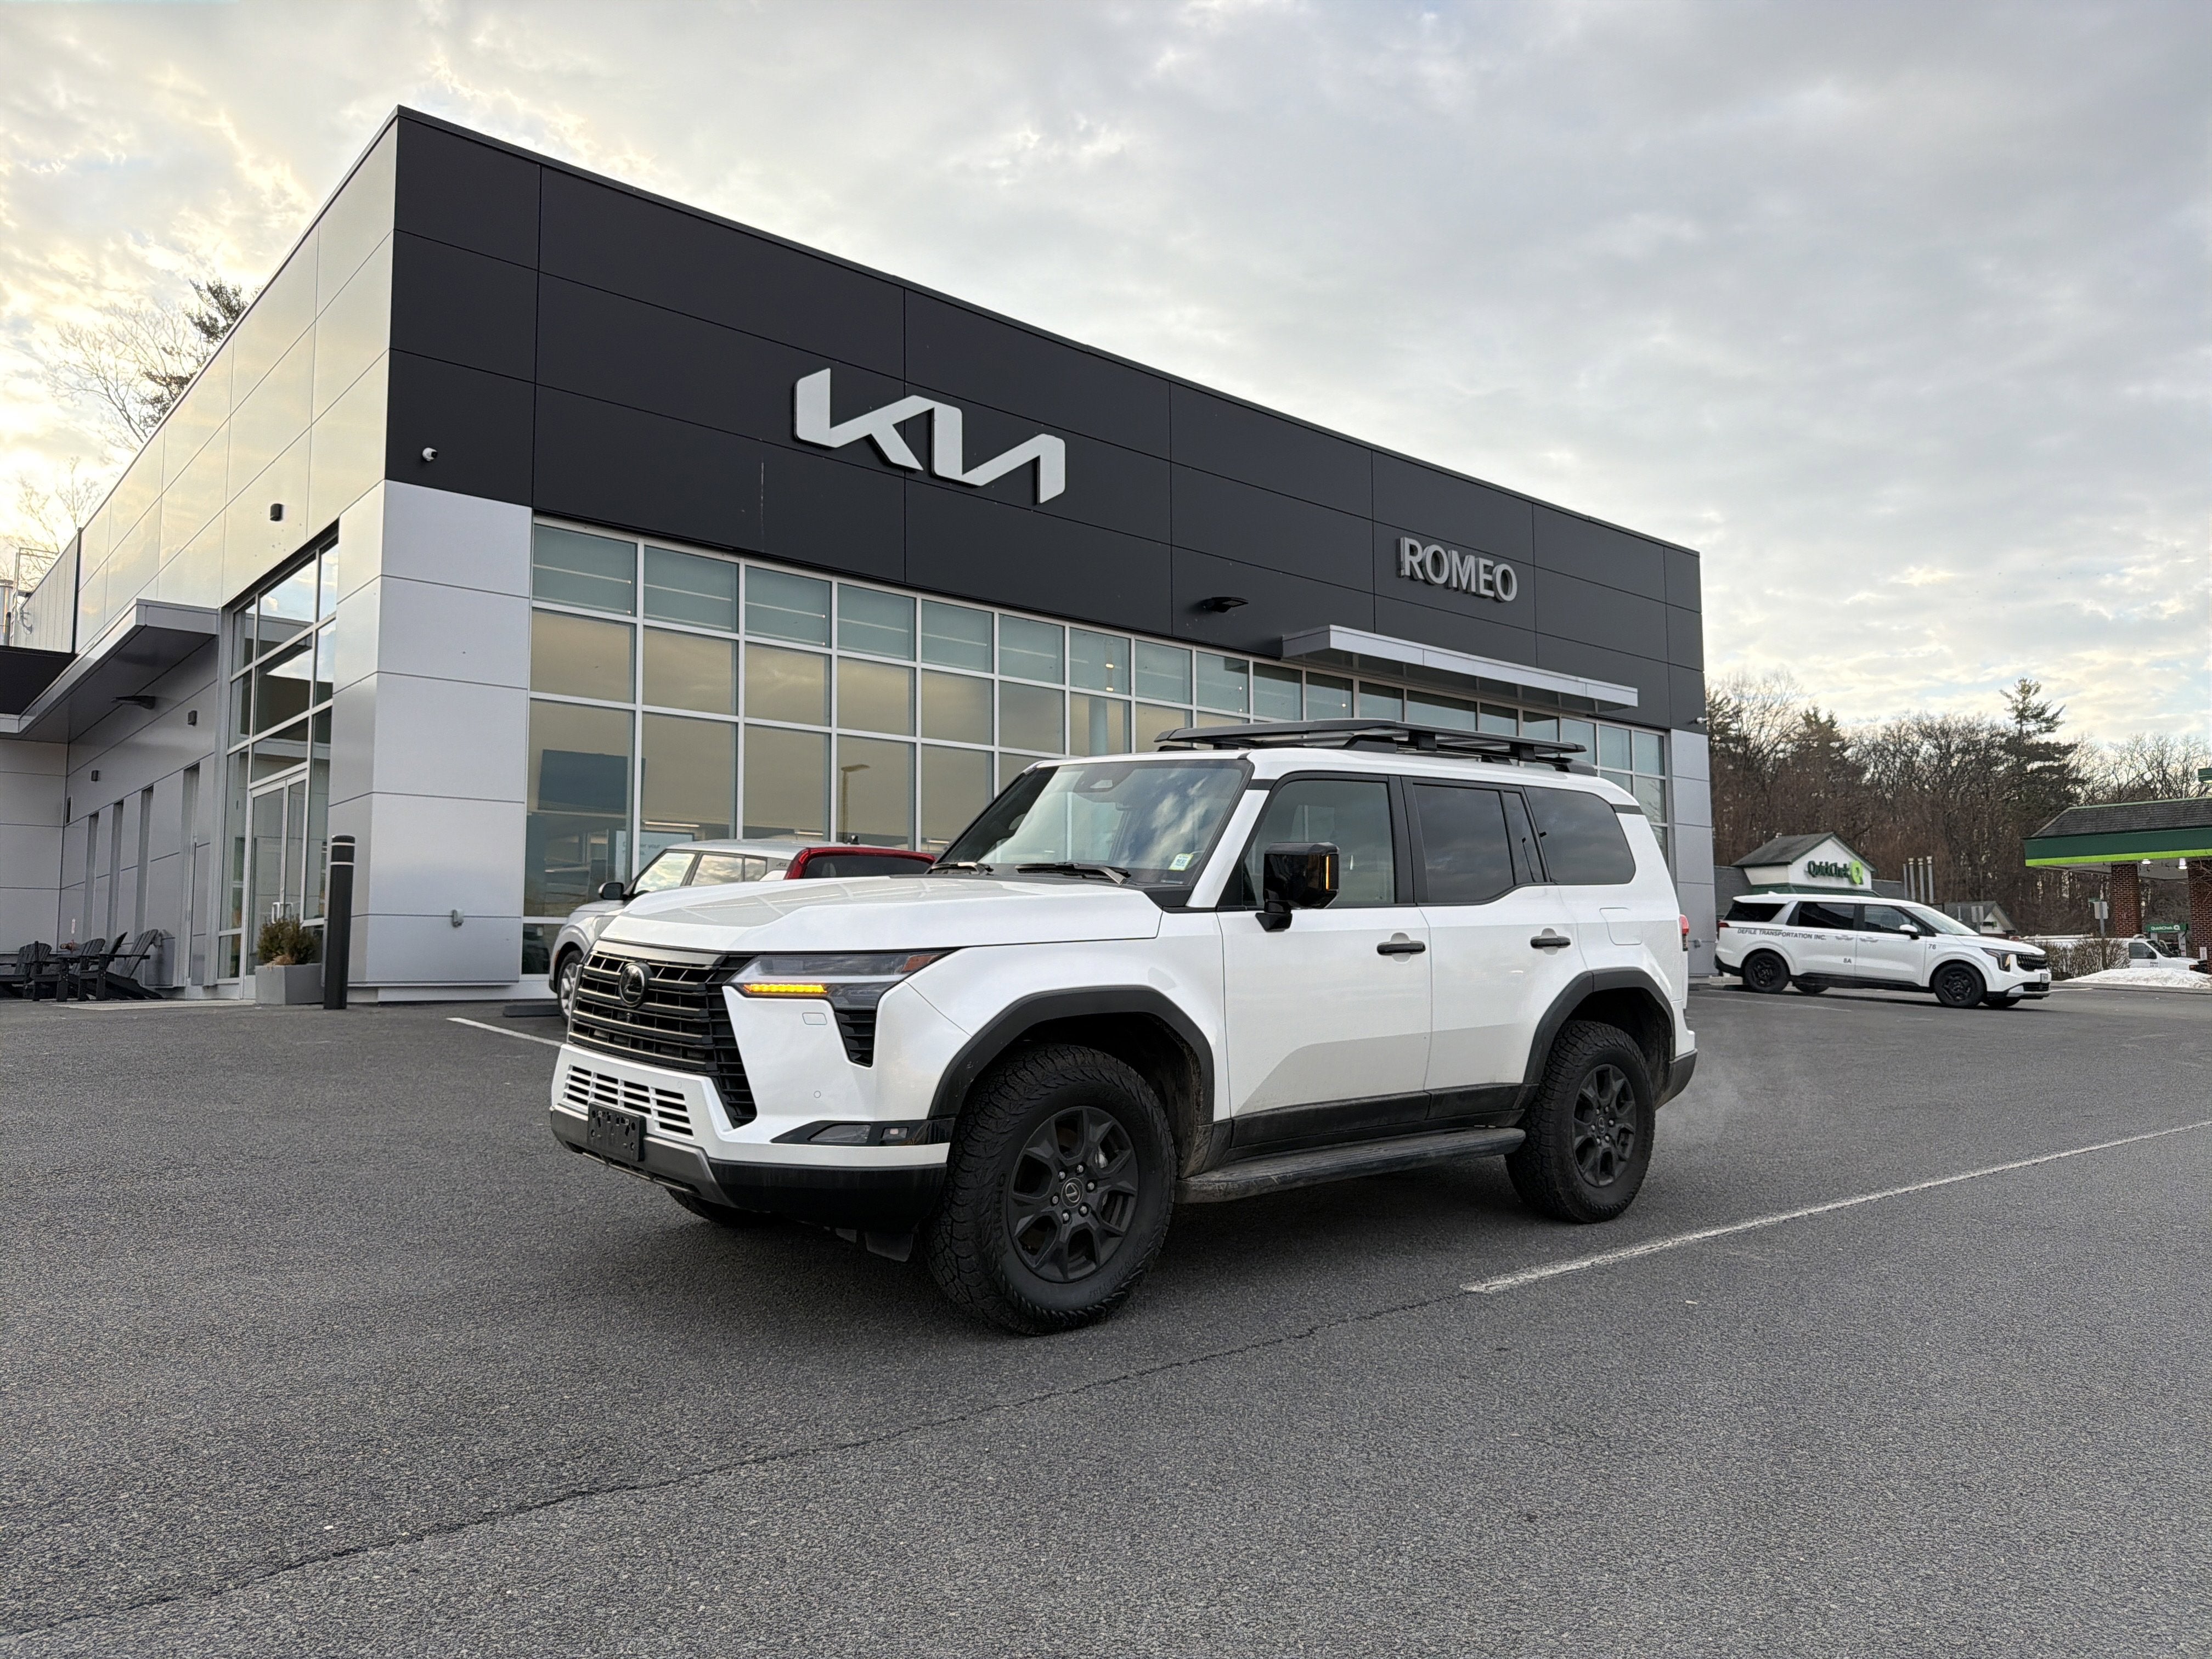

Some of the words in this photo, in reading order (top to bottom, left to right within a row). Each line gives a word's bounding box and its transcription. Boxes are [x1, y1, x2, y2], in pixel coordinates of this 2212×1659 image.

[795, 368, 1065, 504] KIA
[1400, 537, 1517, 601] ROMEO
[1758, 930, 1813, 939] TRANSPORTATION
